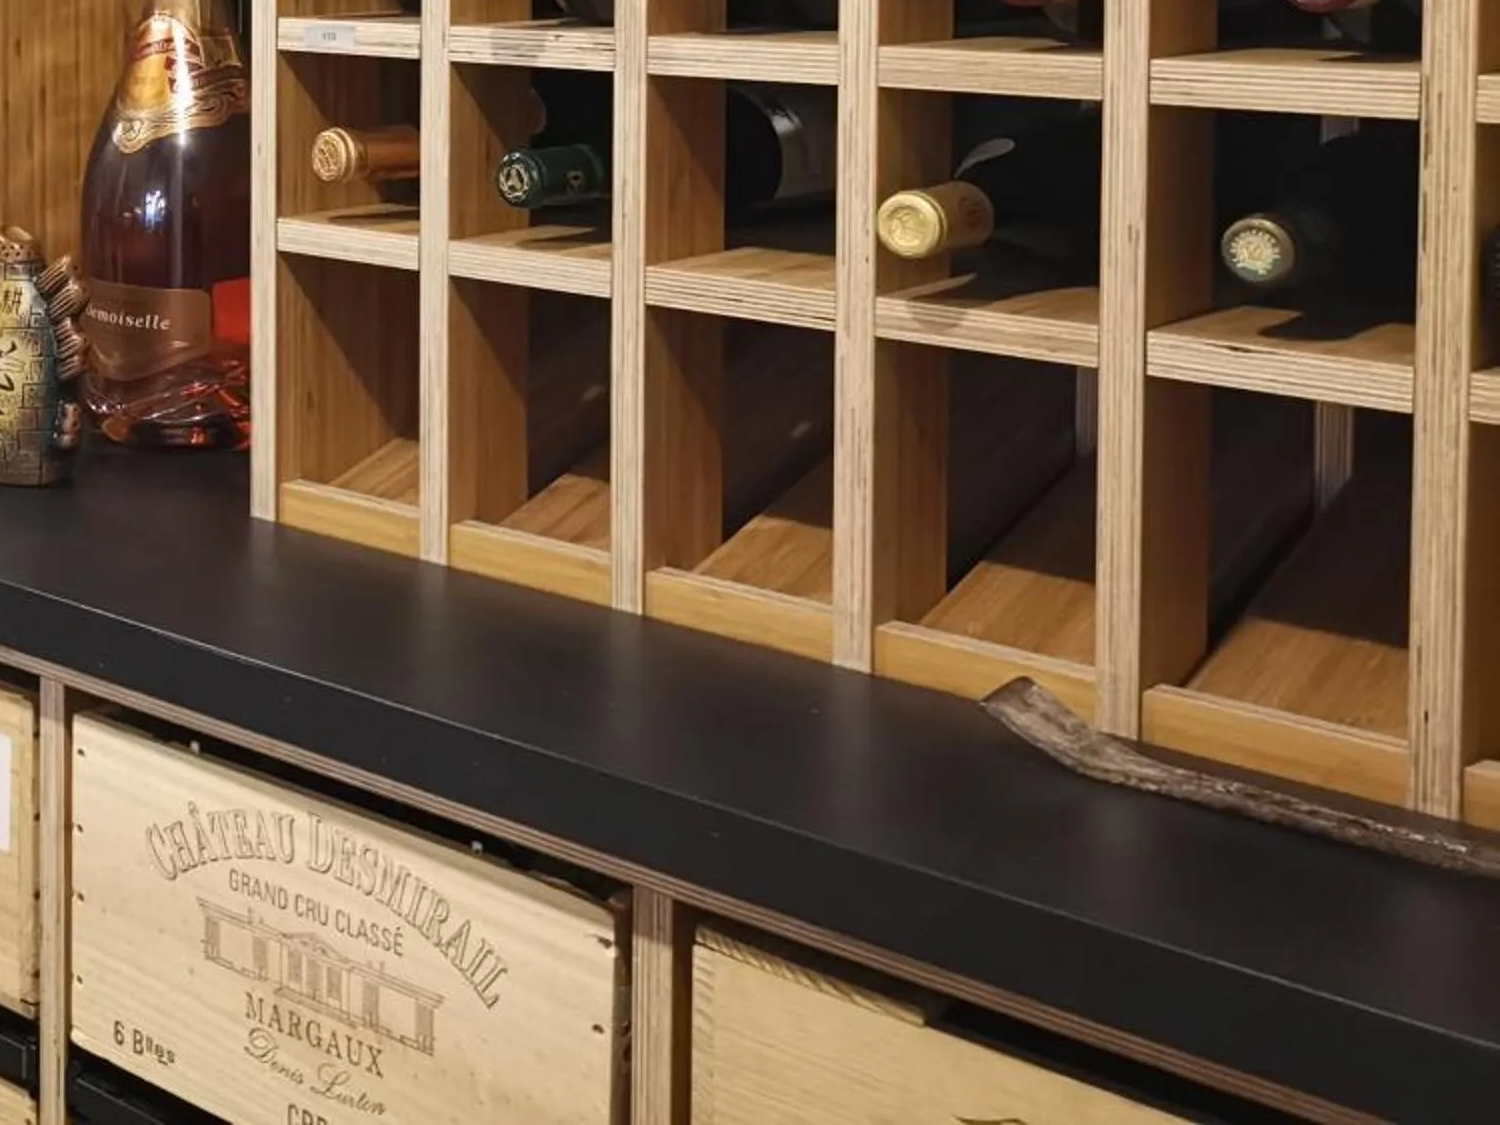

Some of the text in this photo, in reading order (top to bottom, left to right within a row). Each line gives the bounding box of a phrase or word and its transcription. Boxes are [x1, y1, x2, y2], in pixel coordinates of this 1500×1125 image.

[146, 800, 509, 1011] CHÂTEAU DESMIRAIL
[228, 868, 405, 958] GRAND CRU CLASSÉ
[113, 1019, 125, 1046] 6
[244, 990, 384, 1079] MARGAUX
